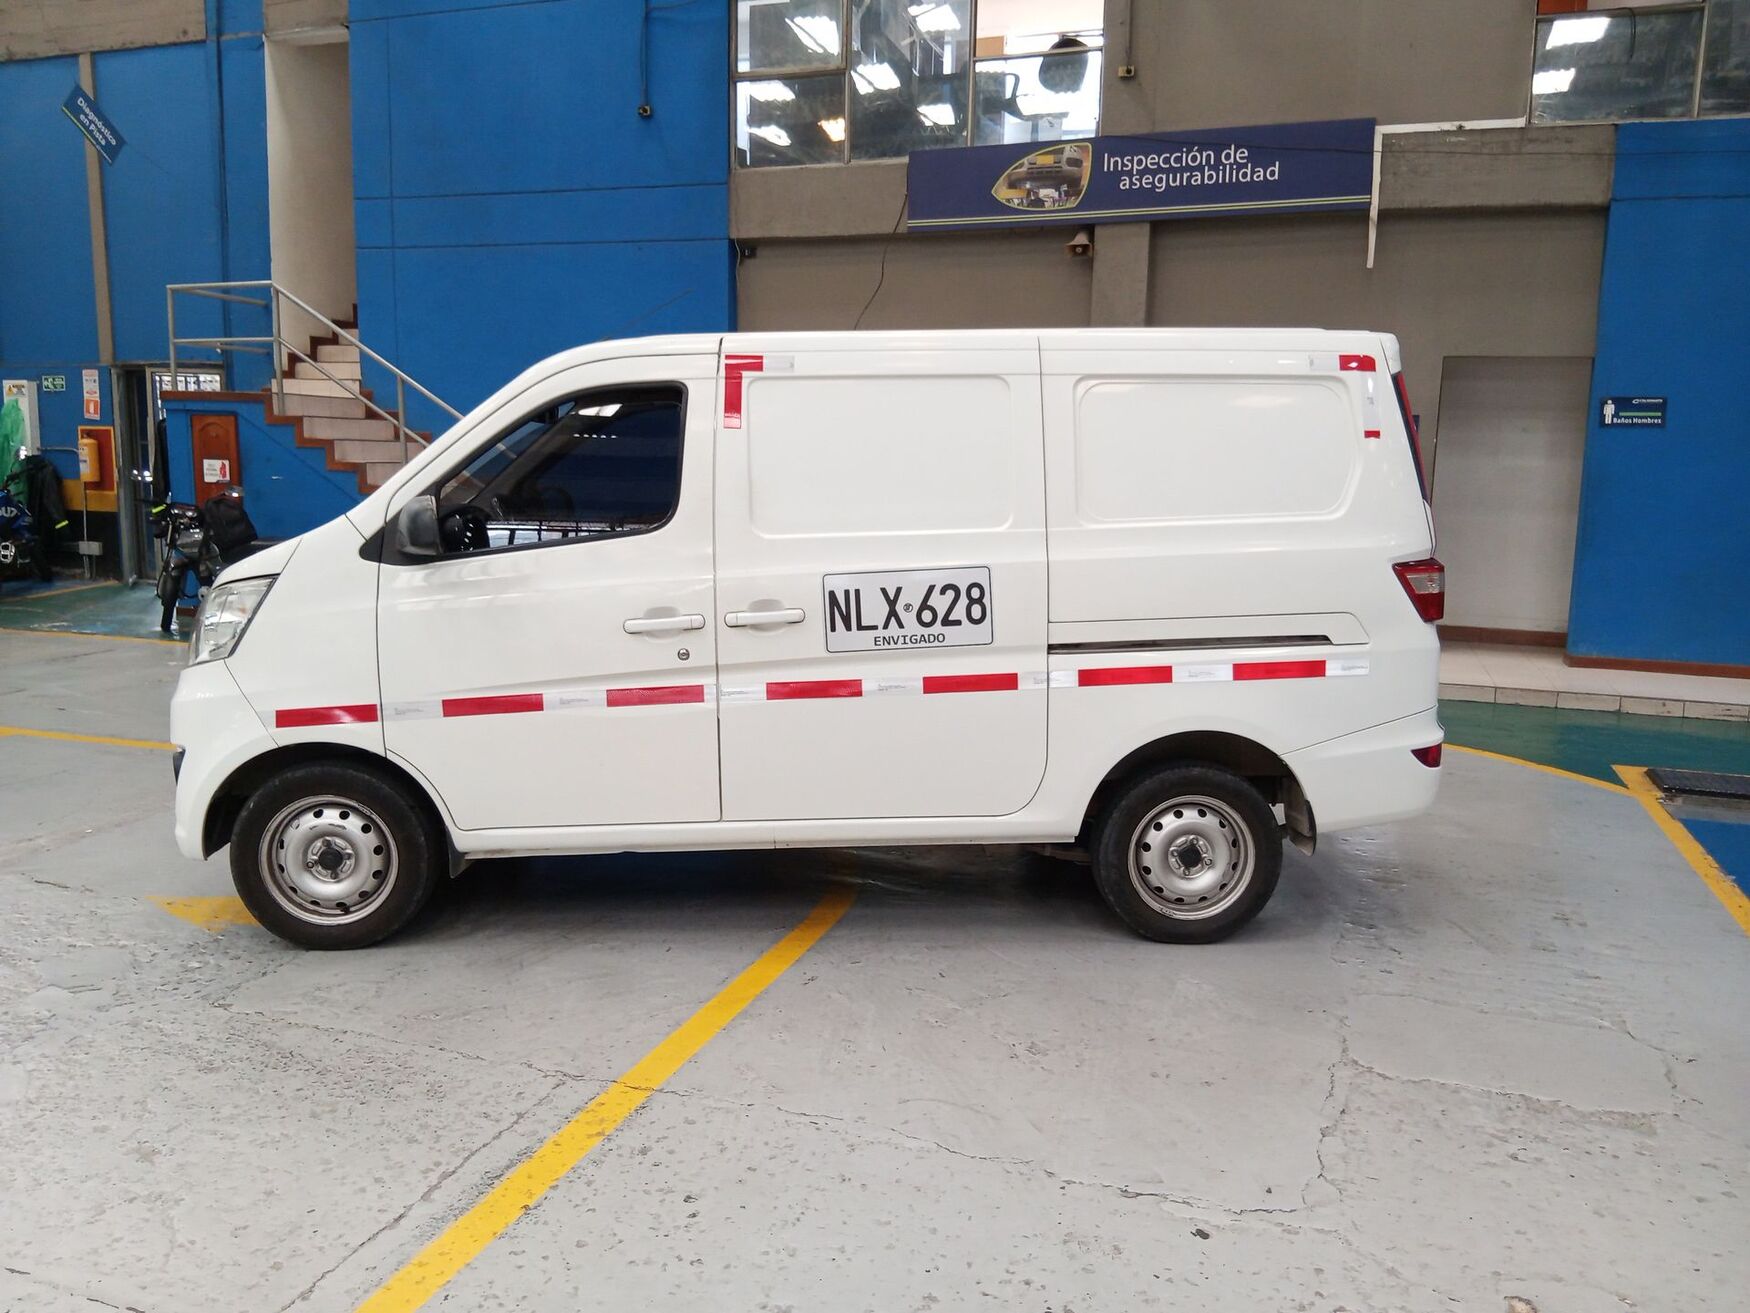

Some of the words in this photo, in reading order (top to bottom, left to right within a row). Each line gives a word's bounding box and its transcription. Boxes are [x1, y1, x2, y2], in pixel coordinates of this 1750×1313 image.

[77, 97, 116, 145] Diagnóstico
[80, 114, 90, 126] en
[89, 124, 106, 145] Pista
[1103, 147, 1214, 173] Inspección
[1220, 144, 1249, 164] de
[1119, 161, 1280, 192] asegurabilidad
[828, 586, 905, 633] NLX
[916, 582, 987, 628] 628
[874, 633, 946, 646] ENVIGADO
